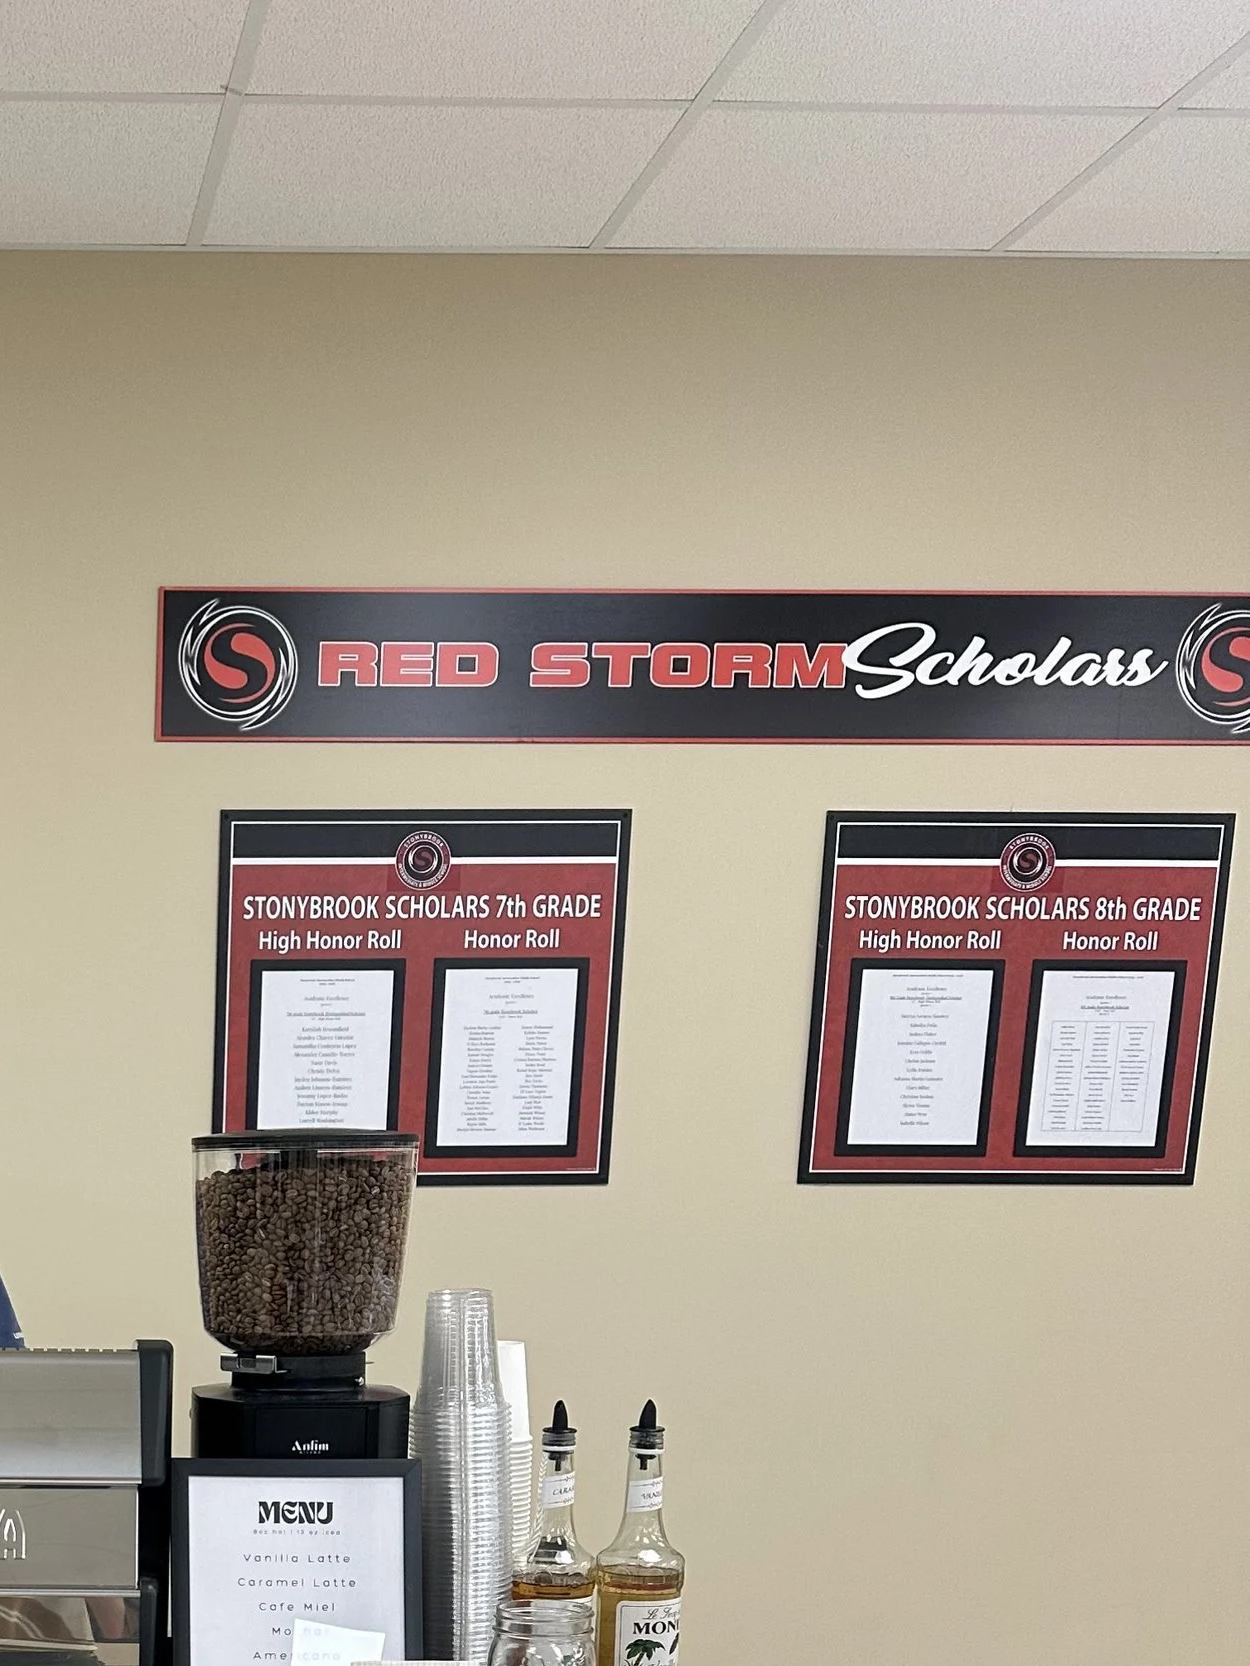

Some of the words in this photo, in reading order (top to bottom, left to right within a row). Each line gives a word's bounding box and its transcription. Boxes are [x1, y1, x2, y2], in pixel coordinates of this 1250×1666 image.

[316, 640, 500, 688] RED
[529, 640, 847, 689] STORM
[841, 621, 1169, 700] Scholars
[242, 894, 379, 921] STONYBROOK
[385, 894, 490, 920] SCHOLARS
[495, 893, 527, 919] 7th
[532, 893, 601, 919] GRADE
[844, 895, 979, 921] STONYBROOK
[985, 895, 1090, 921] SCHOLARS
[1096, 896, 1127, 921] 8th
[1132, 896, 1202, 922] GRADE
[258, 930, 301, 955] High
[305, 930, 363, 951] Honor
[367, 929, 402, 950] Roll
[463, 929, 521, 950] Honor
[525, 928, 560, 949] Roll
[859, 930, 902, 952] High
[906, 931, 963, 951] Honor
[967, 930, 1002, 950] Roll
[1062, 931, 1120, 951] Honor
[1123, 931, 1159, 951] Roll
[291, 1439, 330, 1451] Anfim
[258, 1500, 334, 1525] MENU
[243, 1553, 299, 1564] Vanilla
[307, 1553, 352, 1564] Latte
[237, 1577, 305, 1588] Caramel
[313, 1577, 357, 1588] Latte
[258, 1601, 295, 1613] Cafe
[303, 1602, 336, 1612] Miel
